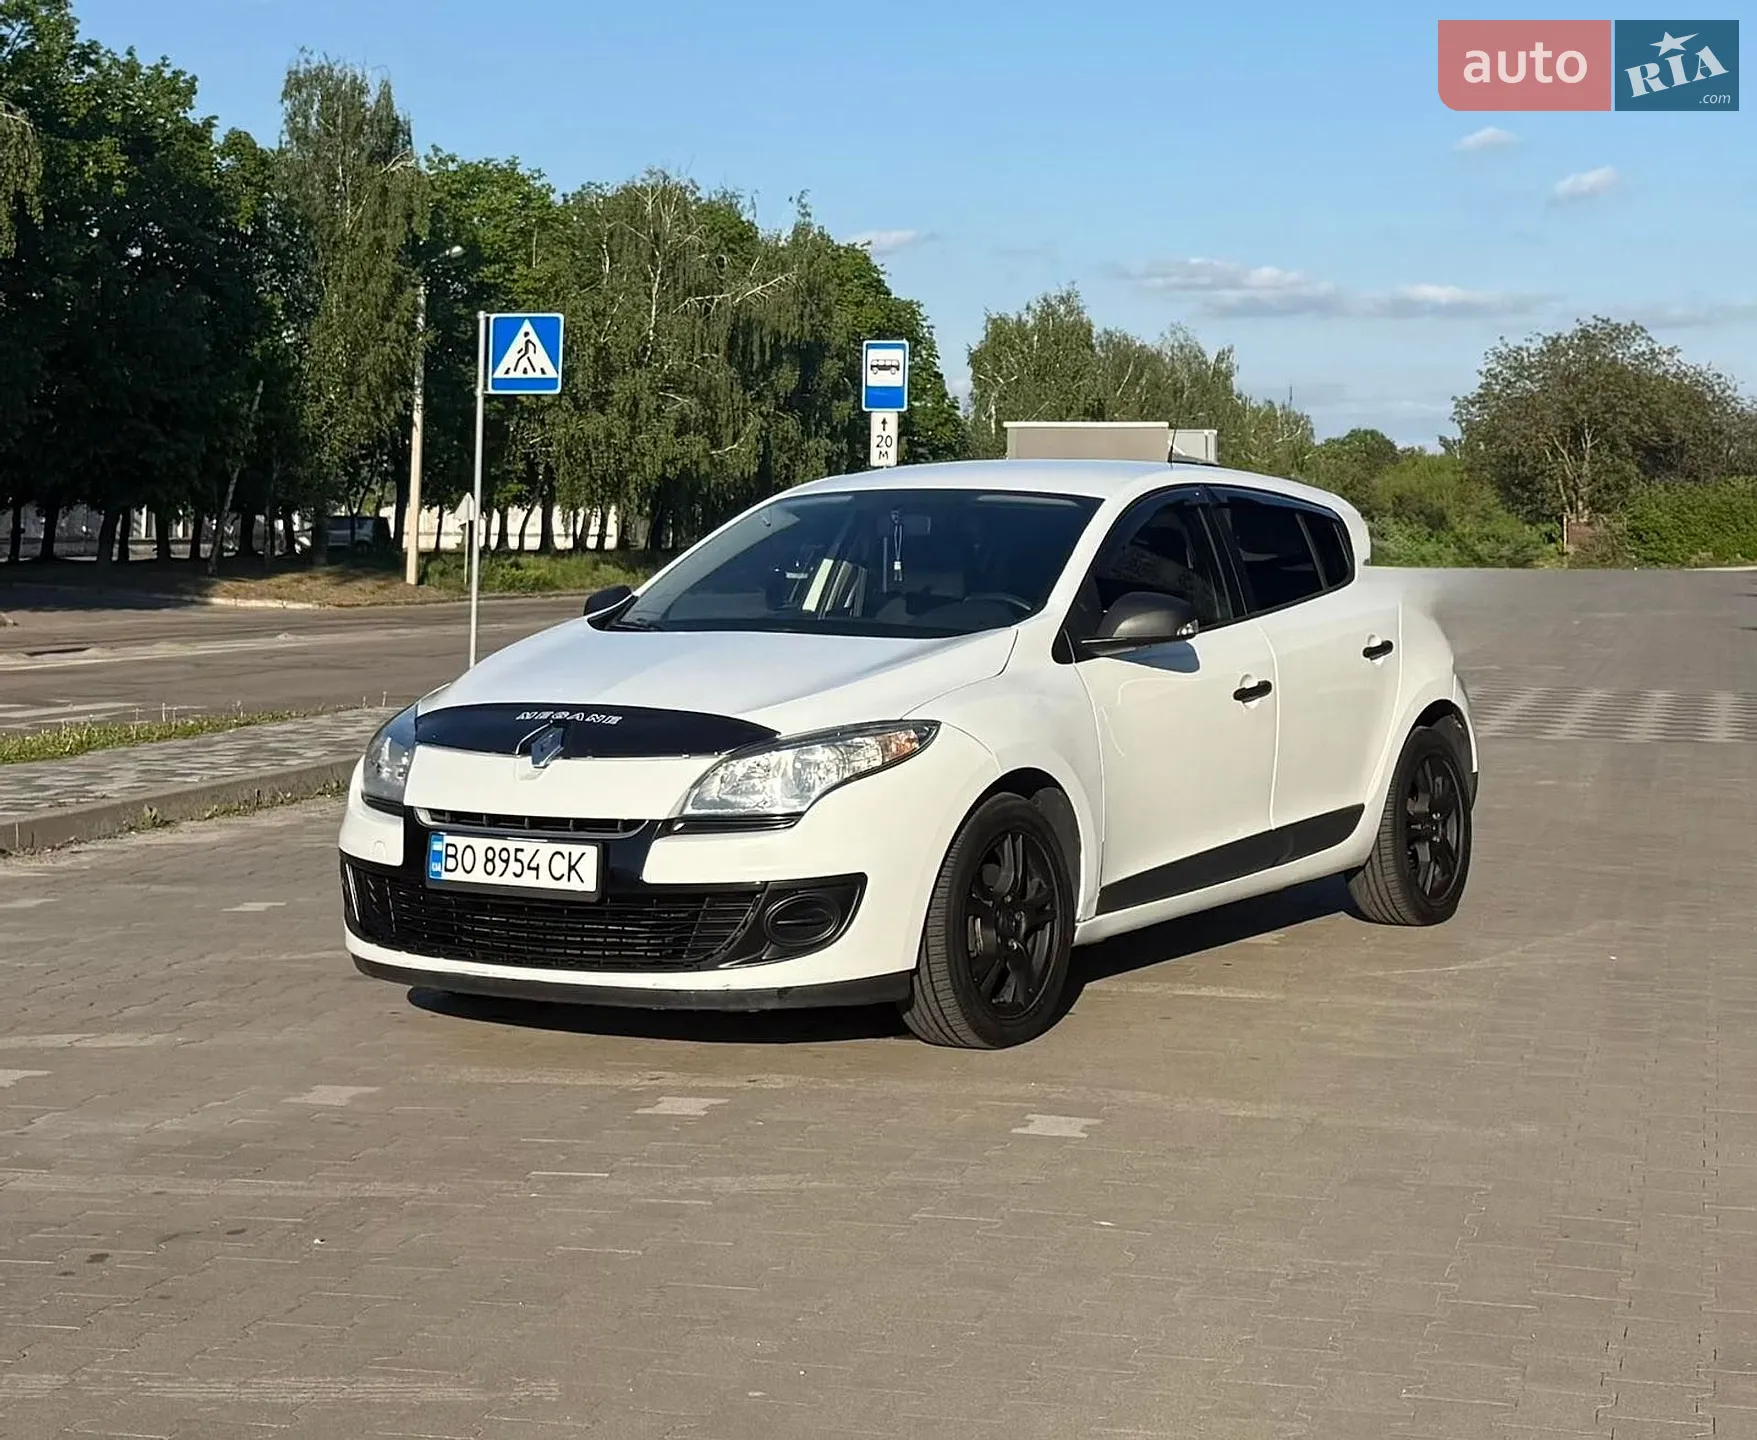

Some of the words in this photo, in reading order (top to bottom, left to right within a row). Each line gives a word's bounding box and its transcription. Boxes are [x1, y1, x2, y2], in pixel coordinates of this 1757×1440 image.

[875, 434, 894, 449] 20
[443, 842, 477, 875] BO
[483, 845, 541, 881] 8954
[548, 850, 587, 884] CK
